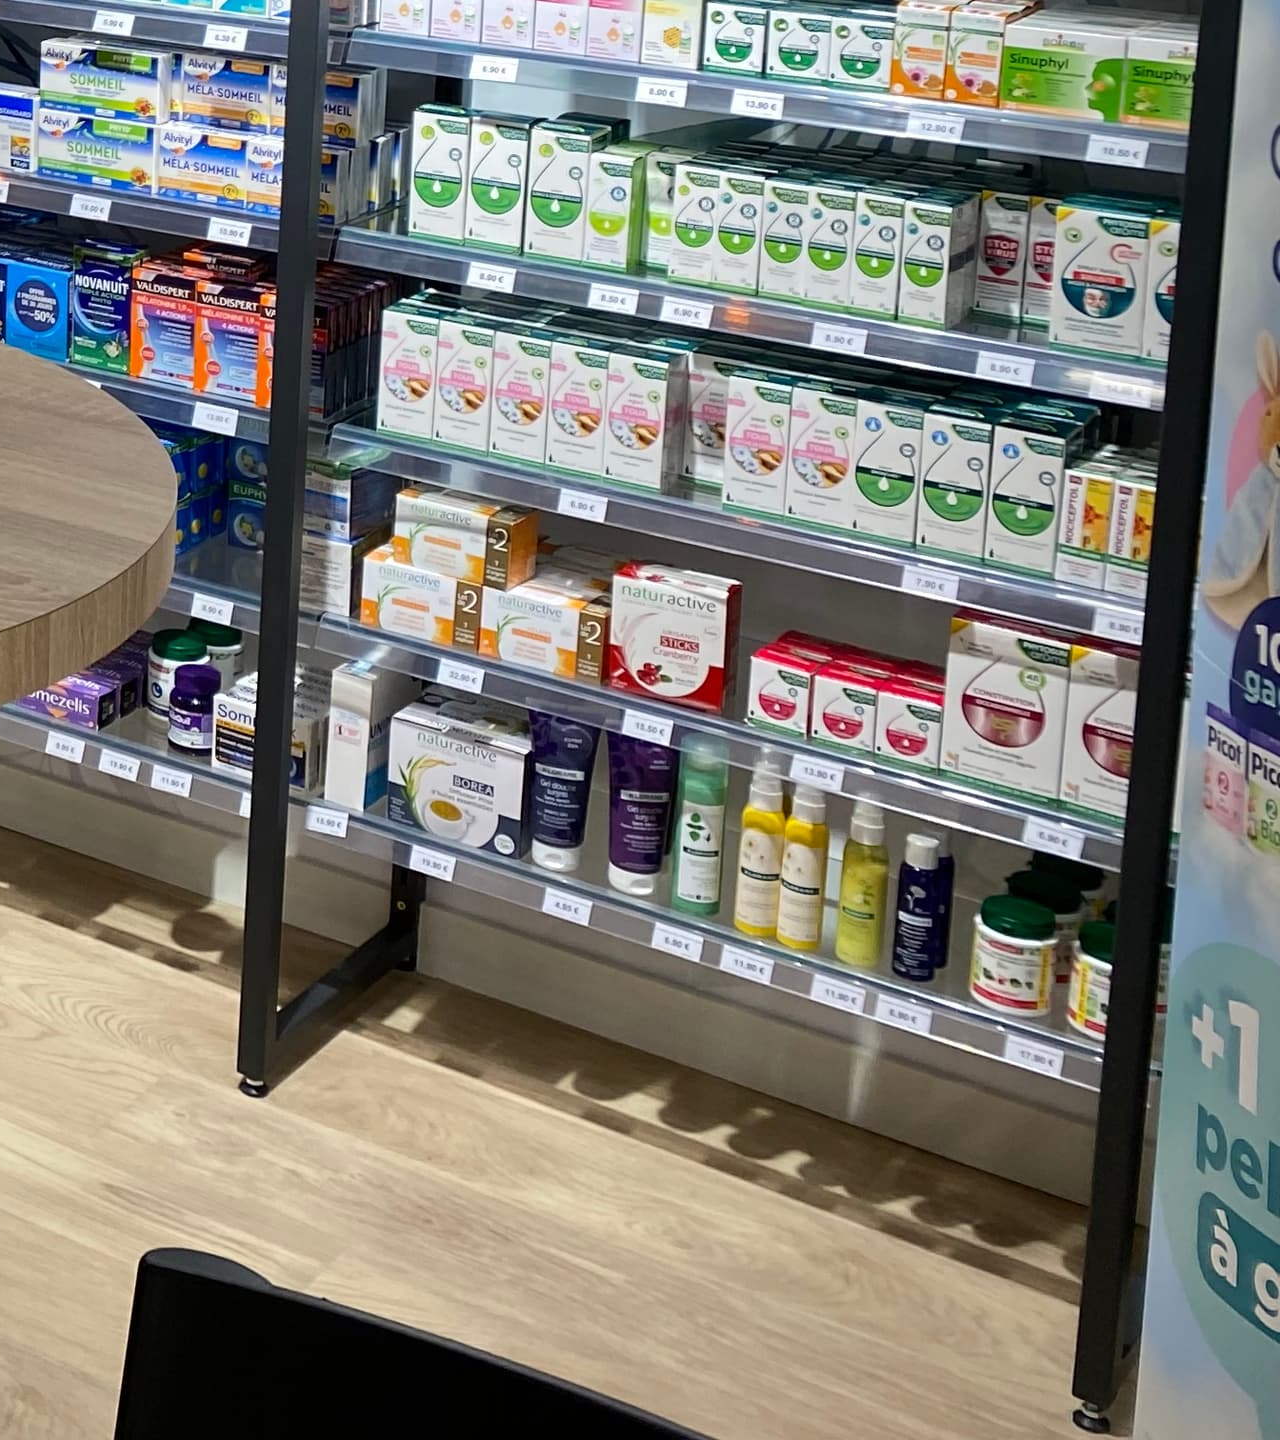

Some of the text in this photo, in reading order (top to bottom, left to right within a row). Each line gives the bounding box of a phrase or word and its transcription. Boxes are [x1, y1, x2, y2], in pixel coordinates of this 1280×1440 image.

[44, 48, 75, 63] Alvityl
[187, 58, 217, 73] Alvityl
[1009, 52, 1070, 71] Sinuphyl
[69, 74, 127, 92] SOMMEIL
[42, 114, 70, 129] Alvityl
[163, 132, 193, 146] Alvityl
[66, 141, 122, 161] SOMMEIL
[986, 239, 1019, 250] STOP
[75, 272, 129, 295] NOVANUIT
[136, 280, 190, 299] VALDISPERT
[201, 294, 258, 312] VALDISPERT
[233, 484, 267, 500] EUPHY
[410, 502, 472, 526] naturactive
[1064, 486, 1081, 545] NOCICEPTOL
[1114, 497, 1131, 556] NOCICEPTOL
[494, 527, 510, 552] 2
[378, 564, 441, 588] naturactive
[462, 590, 478, 614] 2
[497, 593, 563, 619] naturactive
[621, 583, 717, 614] naturactive
[586, 622, 603, 645] 2
[660, 636, 700, 652] STICKS
[652, 646, 700, 664] Cranberry
[217, 703, 255, 726] Som
[416, 730, 498, 763] naturactive
[1207, 725, 1242, 766] Picot
[453, 775, 495, 796] BOREA
[1209, 1209, 1239, 1289] à
